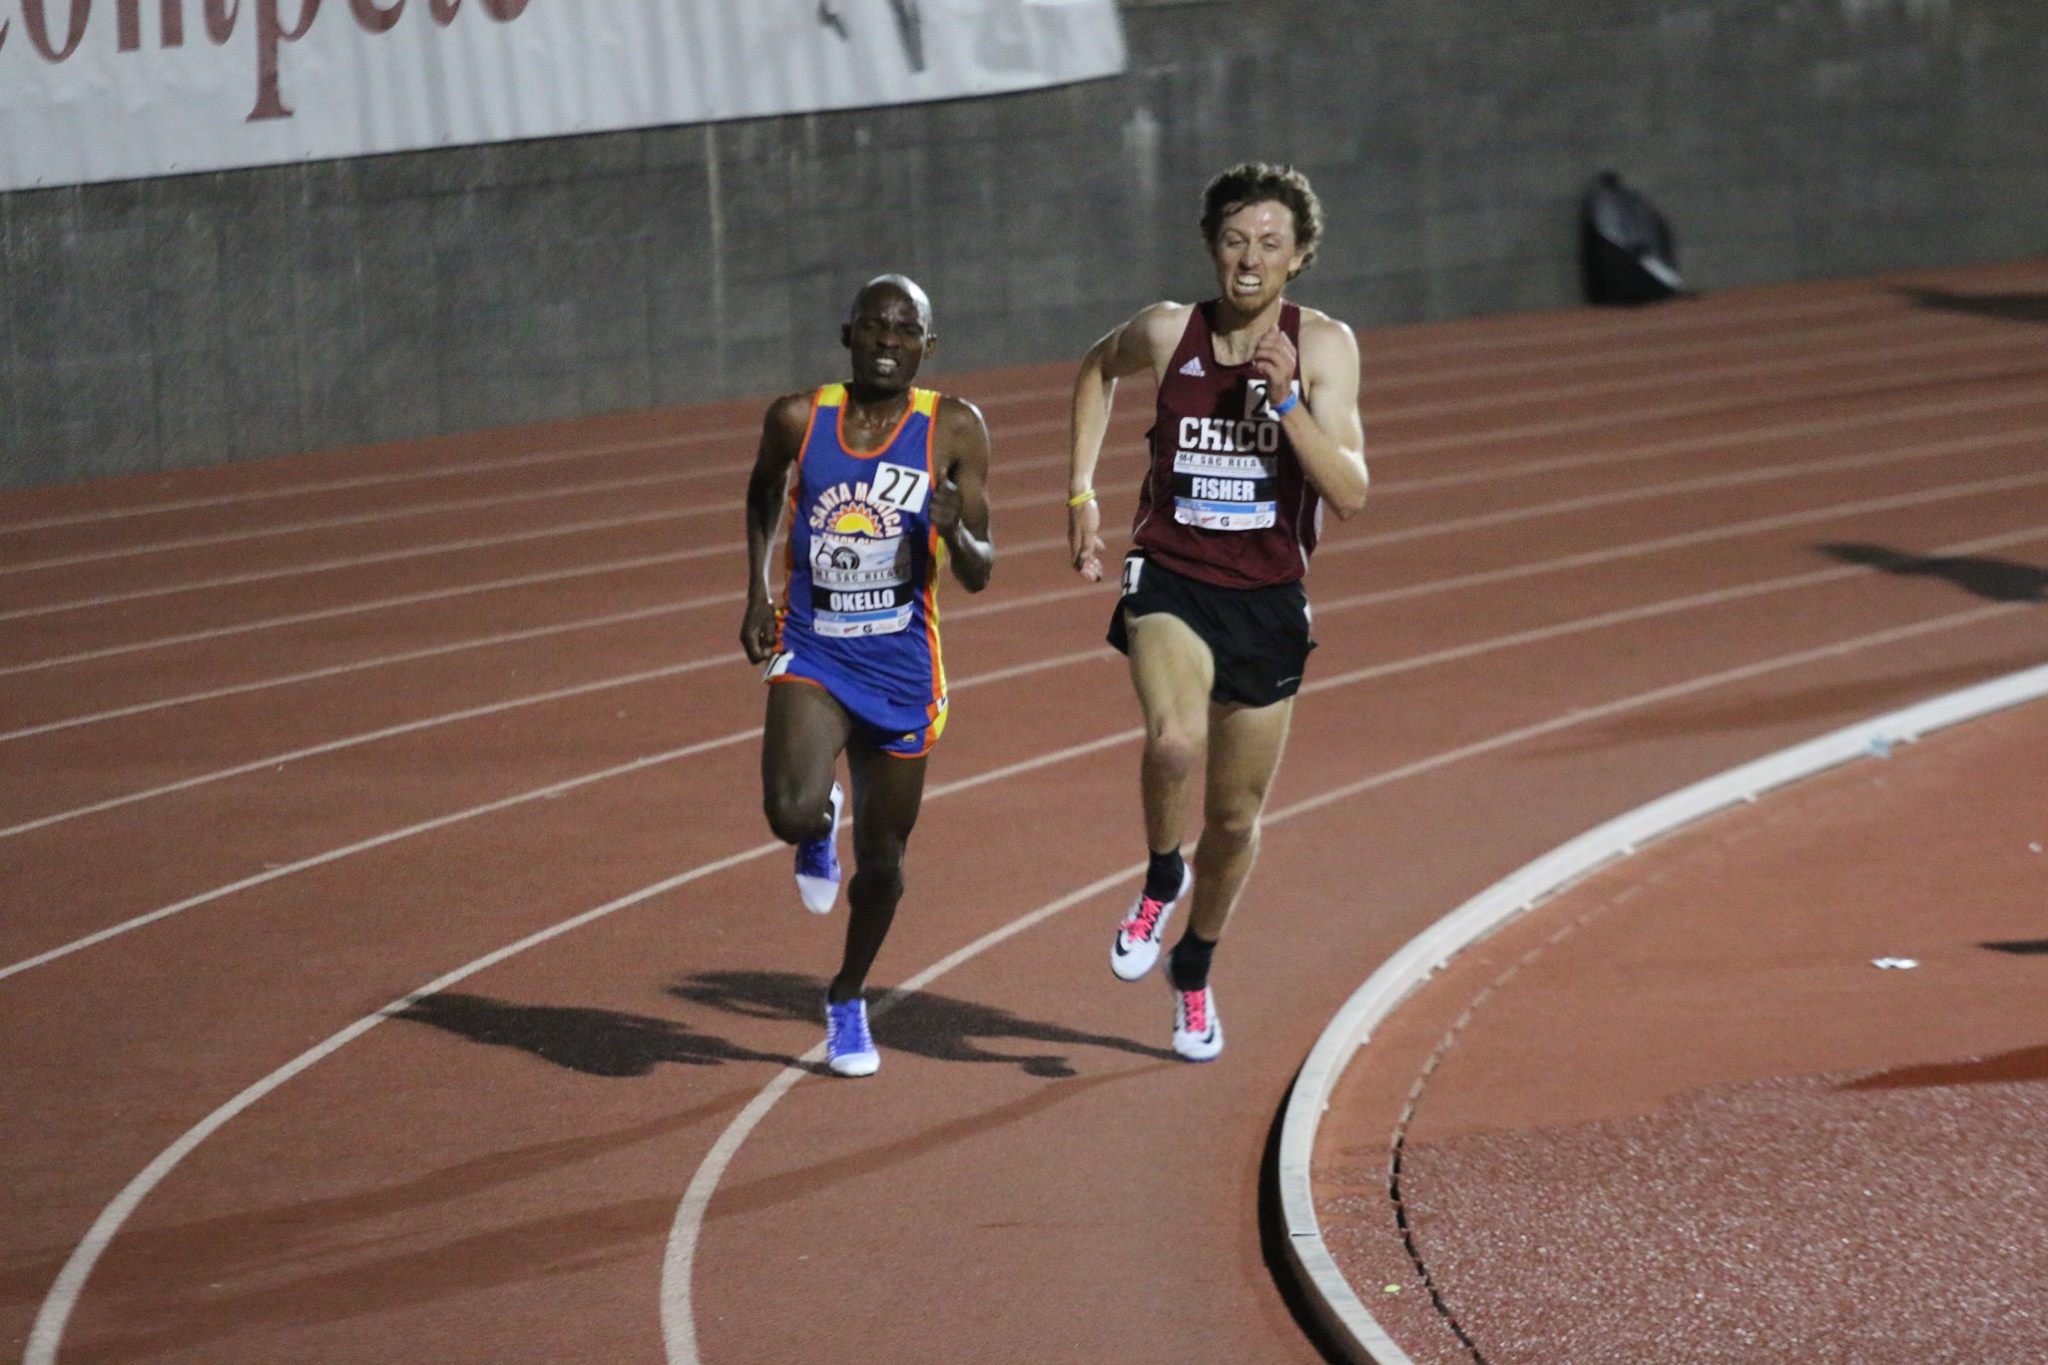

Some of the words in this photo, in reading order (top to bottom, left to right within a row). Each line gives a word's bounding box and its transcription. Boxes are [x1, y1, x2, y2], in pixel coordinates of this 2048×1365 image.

[1178, 417, 1279, 453] CHICO
[878, 467, 921, 506] 27
[1191, 477, 1256, 501] FISHER
[809, 482, 852, 529] SANTA
[829, 588, 896, 612] OKELLO
